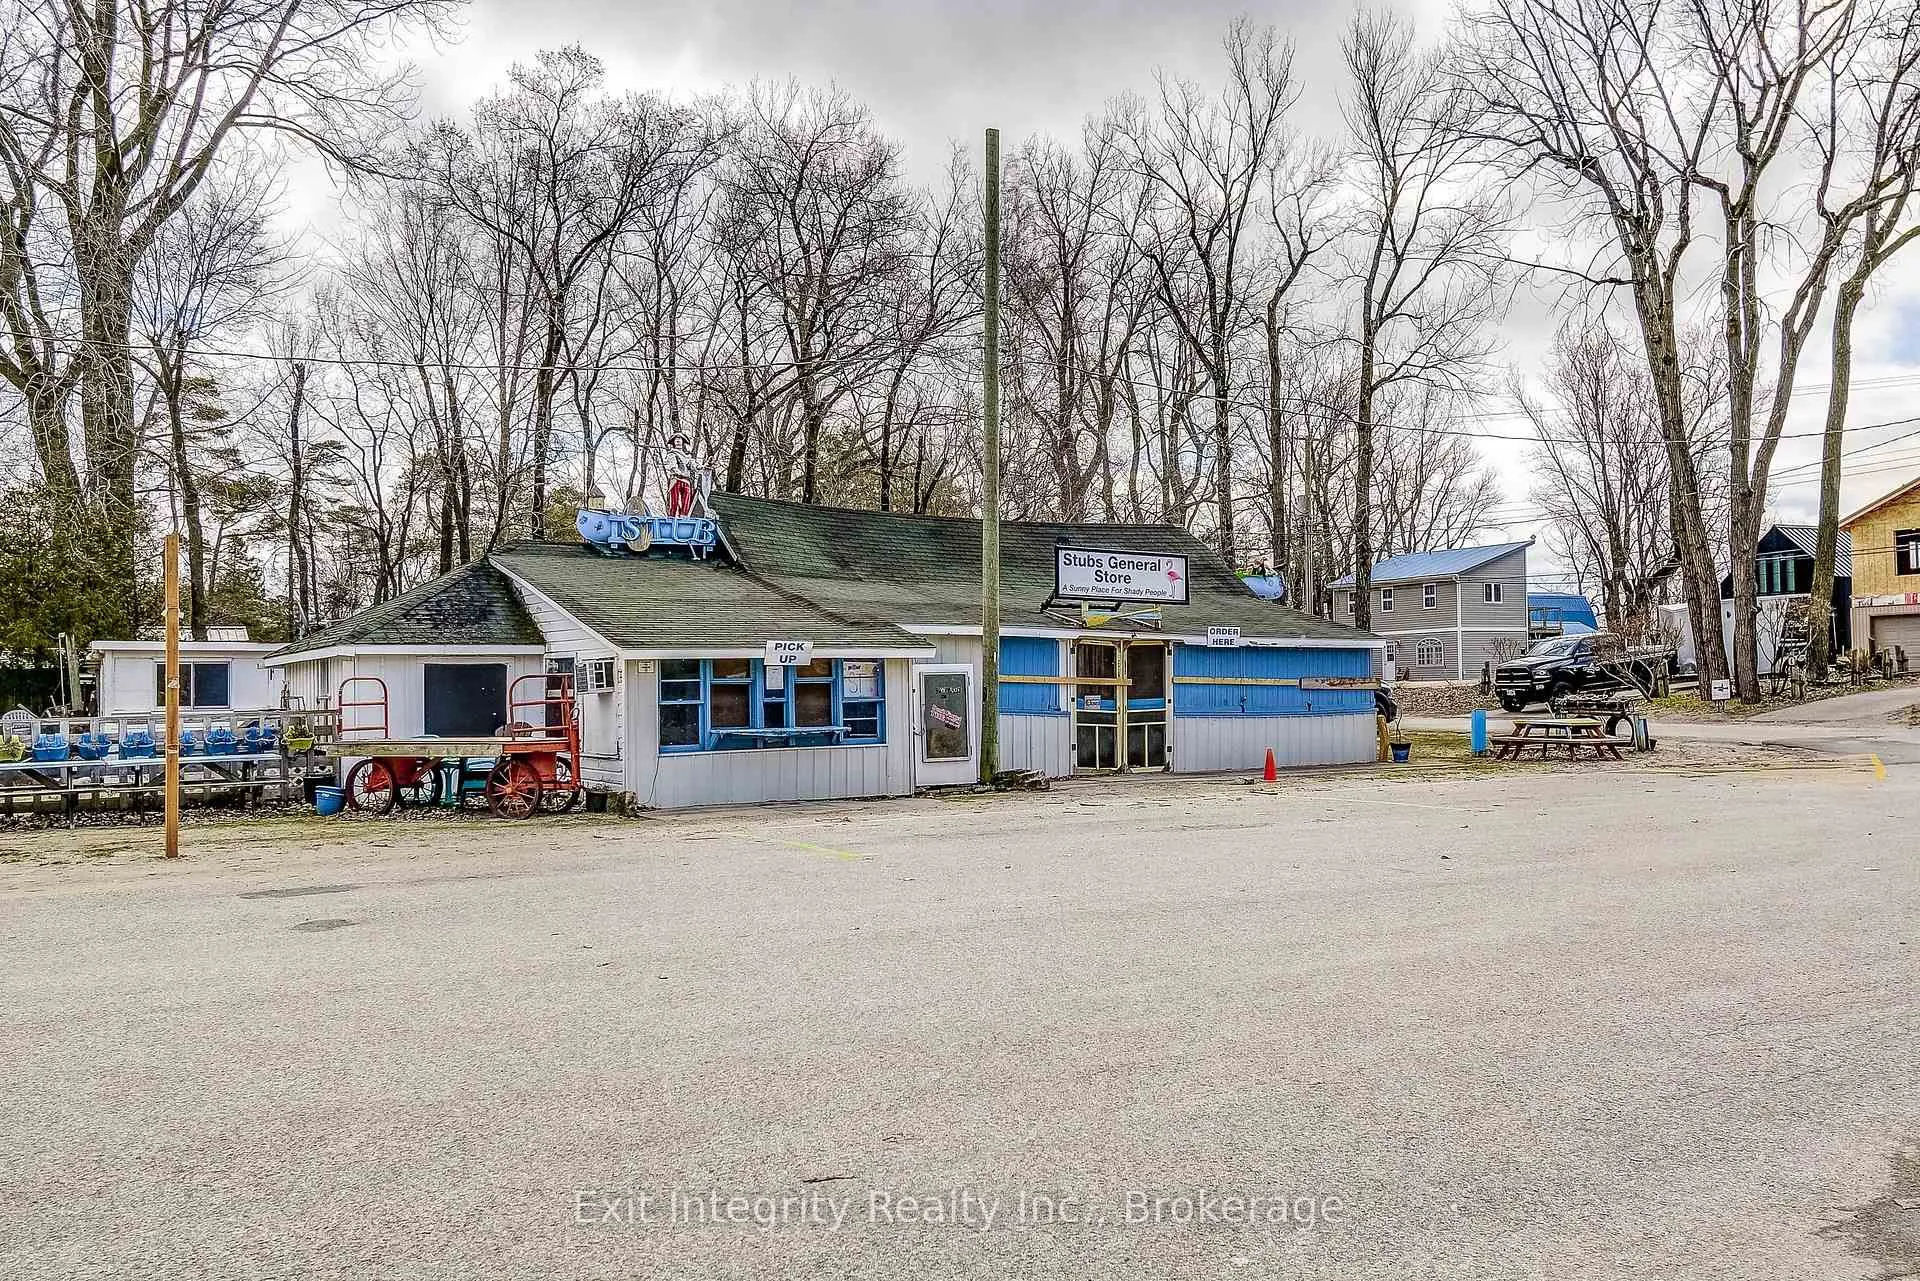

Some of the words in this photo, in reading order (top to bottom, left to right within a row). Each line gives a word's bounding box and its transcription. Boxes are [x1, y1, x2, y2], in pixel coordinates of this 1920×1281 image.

[1063, 552, 1103, 569] Stubs
[1108, 556, 1161, 572] General
[1094, 569, 1132, 584] Store
[1062, 583, 1068, 592] A
[1069, 584, 1090, 594] Sunny
[1091, 585, 1110, 595] Place
[1111, 586, 1123, 595] For
[1123, 586, 1144, 597] Shady
[1145, 588, 1168, 598] People
[1209, 628, 1239, 636] ORDER
[774, 642, 806, 651] PICK
[1212, 638, 1235, 646] HERE
[779, 655, 797, 664] UP
